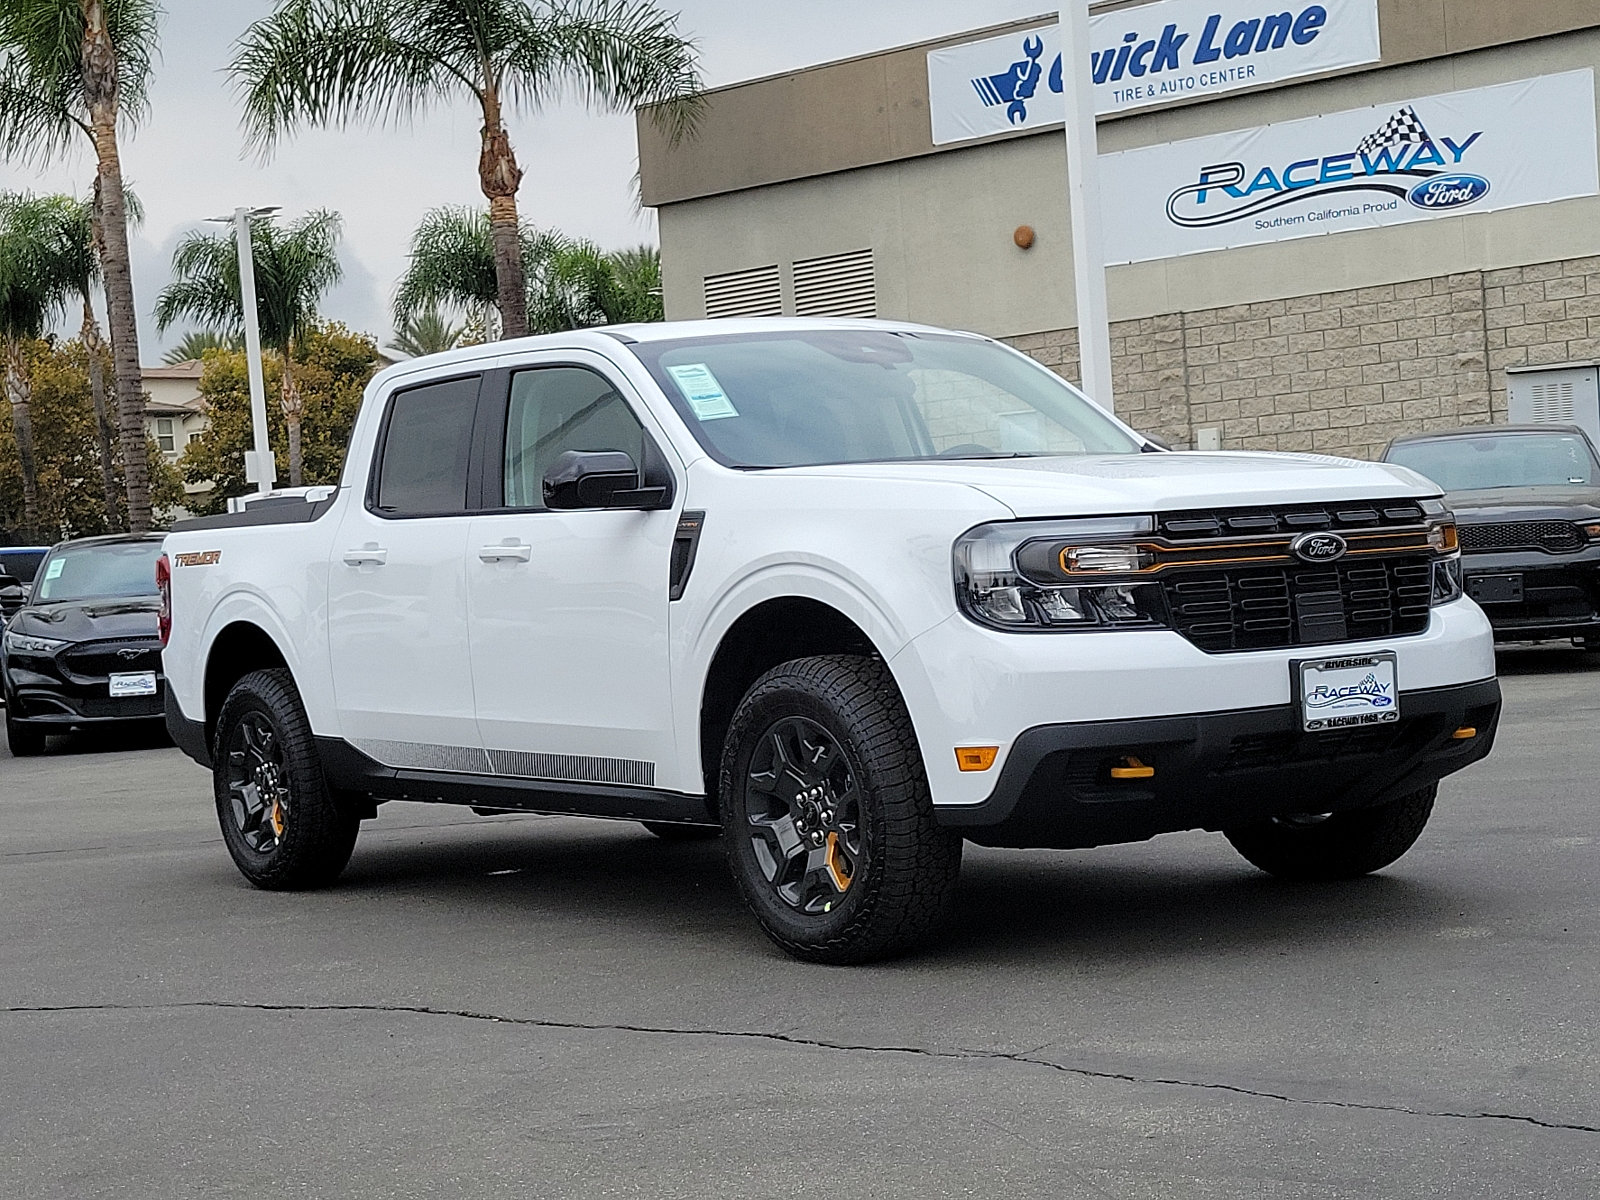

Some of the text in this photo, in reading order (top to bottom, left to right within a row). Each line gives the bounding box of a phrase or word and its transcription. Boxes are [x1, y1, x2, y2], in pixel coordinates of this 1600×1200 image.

[1193, 5, 1327, 64] Lane
[1113, 65, 1256, 103] TIRE & AUTO CENTER
[1196, 131, 1484, 205] RACEWAY
[1424, 180, 1473, 206] Ford
[1255, 200, 1397, 230] Southern California Proud
[175, 551, 221, 567] TREMOR
[1309, 538, 1337, 556] Ford
[1313, 682, 1391, 700] RACEWAY
